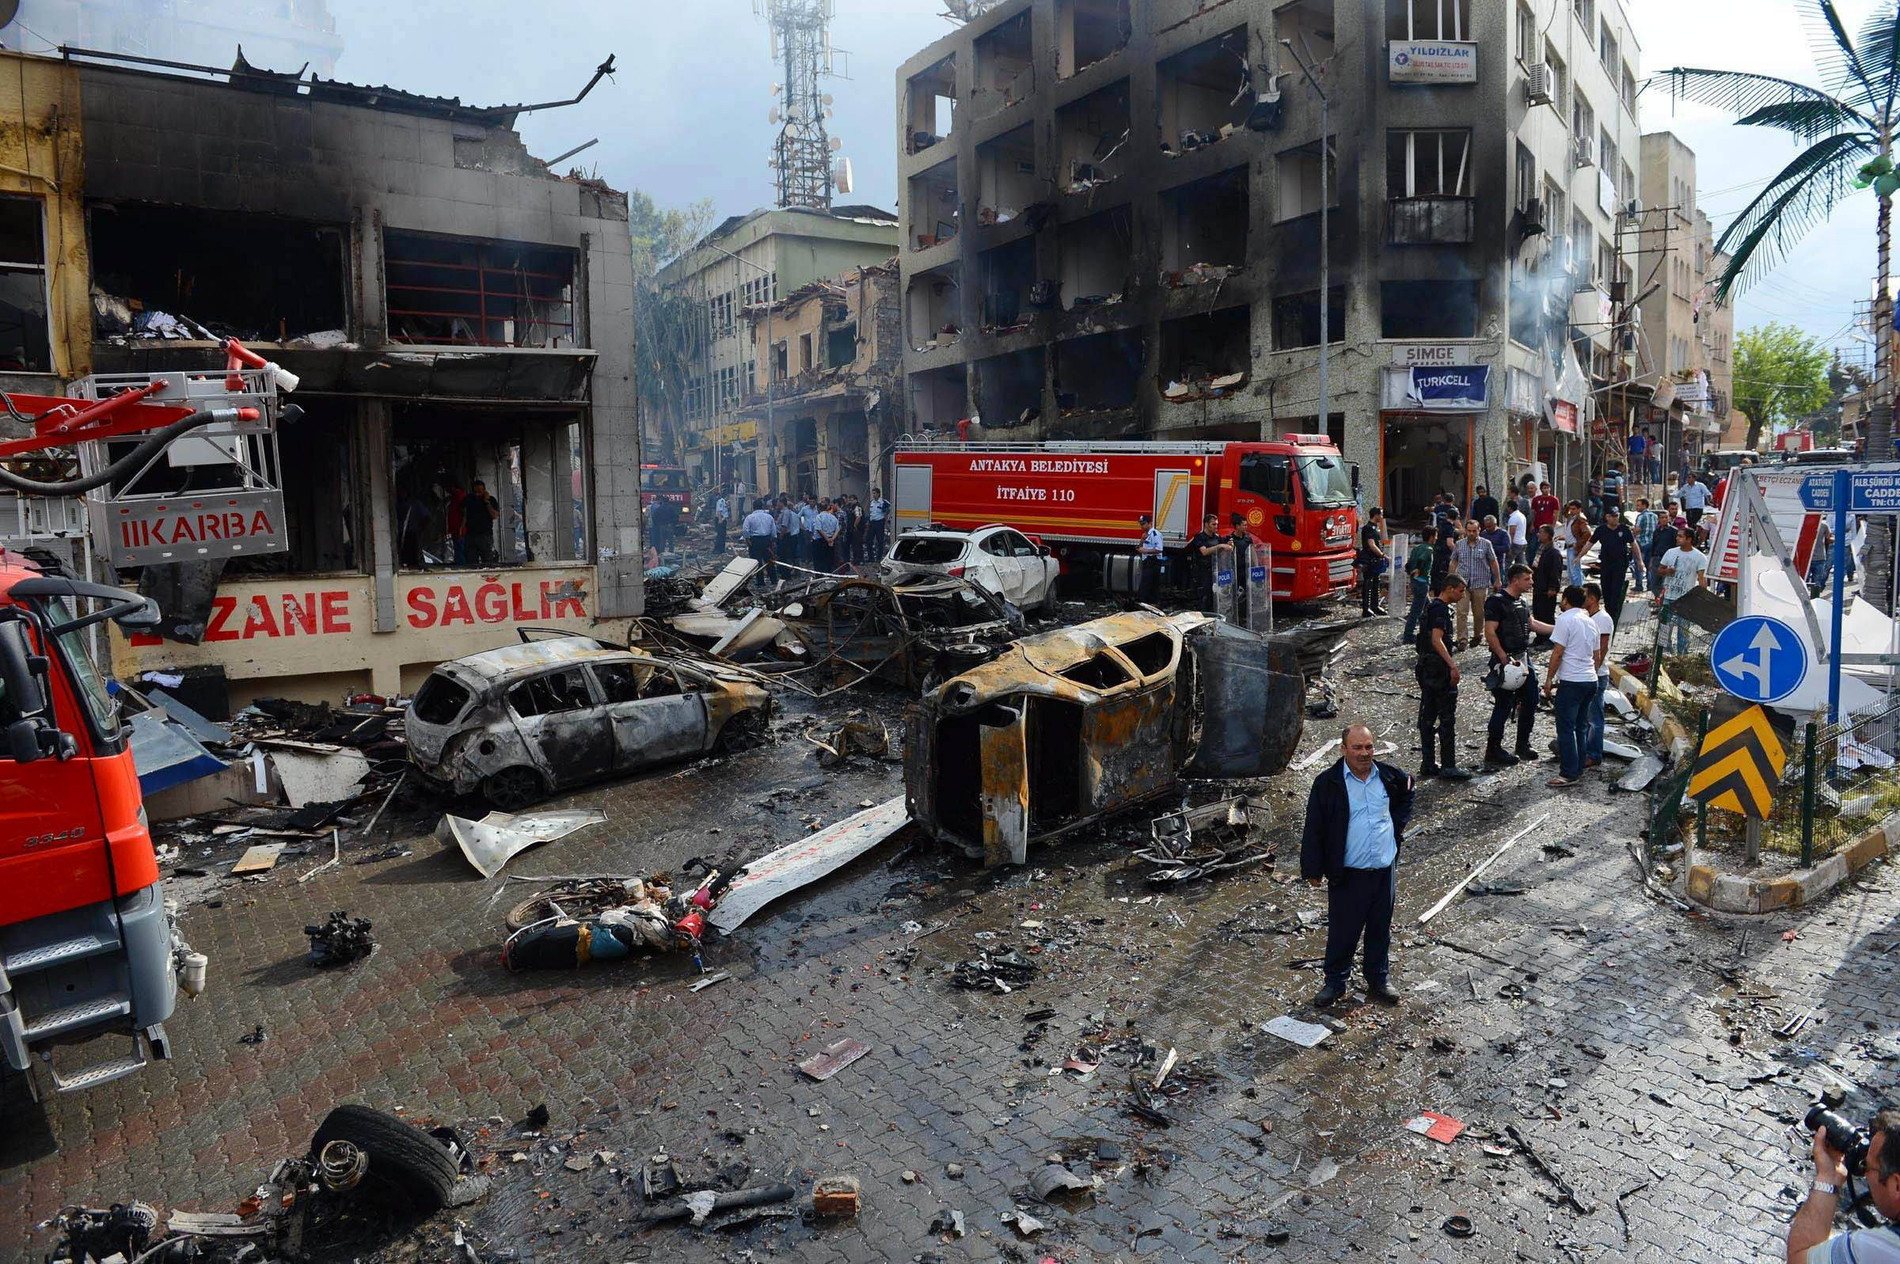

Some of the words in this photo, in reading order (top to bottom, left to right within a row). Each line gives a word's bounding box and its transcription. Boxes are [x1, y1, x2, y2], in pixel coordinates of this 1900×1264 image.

[1410, 46, 1470, 57] YILDIZLAR
[1417, 375, 1471, 388] TURKCELL
[969, 459, 1027, 472] ANTAKYA
[1030, 459, 1108, 473] BELEDİYESİ
[996, 485, 1046, 500] İTFAİYE
[1051, 489, 1074, 502] 110
[131, 590, 350, 647] ZANE
[407, 575, 587, 629] SAĞLIK
[23, 826, 86, 849] 3340
